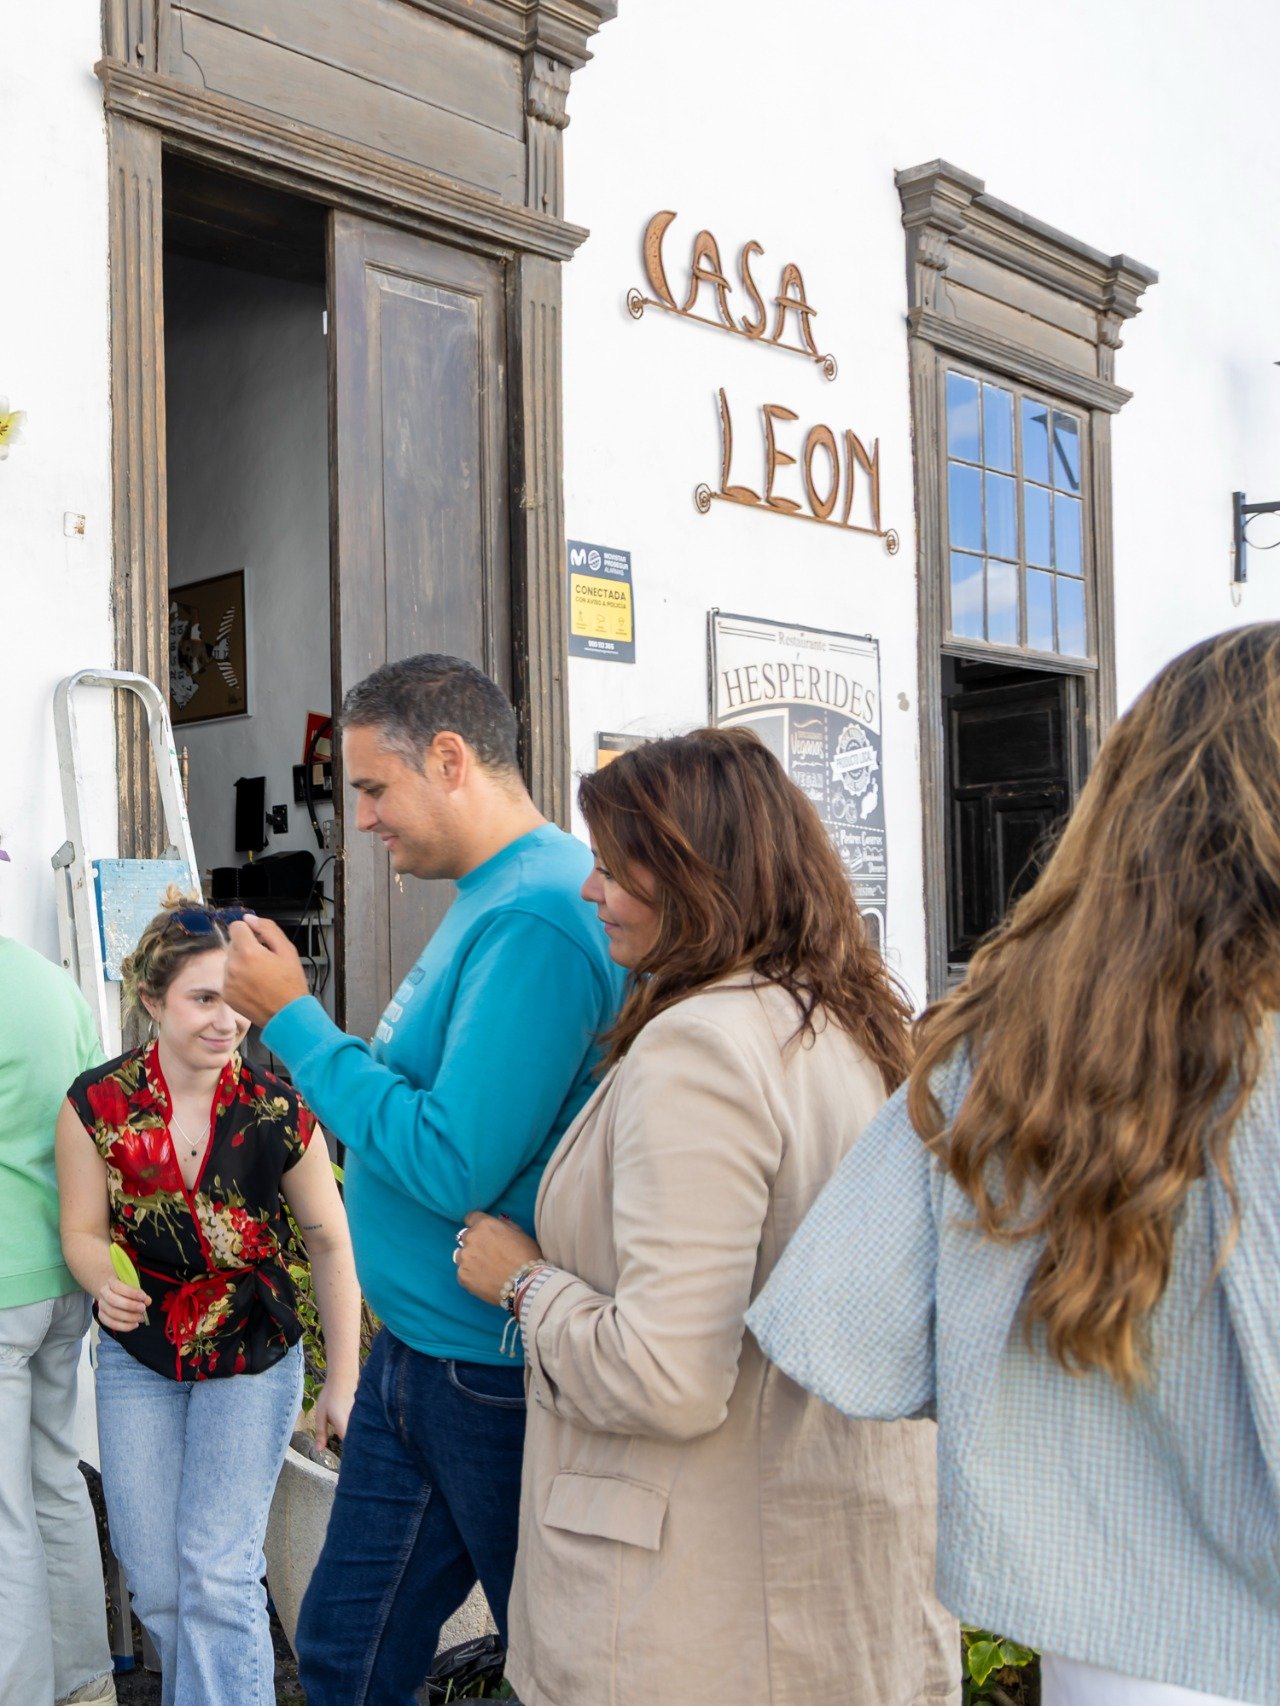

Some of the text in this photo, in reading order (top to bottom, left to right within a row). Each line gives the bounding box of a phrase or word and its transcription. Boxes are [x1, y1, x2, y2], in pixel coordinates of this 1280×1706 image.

[643, 210, 819, 355] CASA
[719, 388, 881, 531] LEON
[575, 584, 627, 601] CONECTADA
[778, 631, 826, 651] Restaurante
